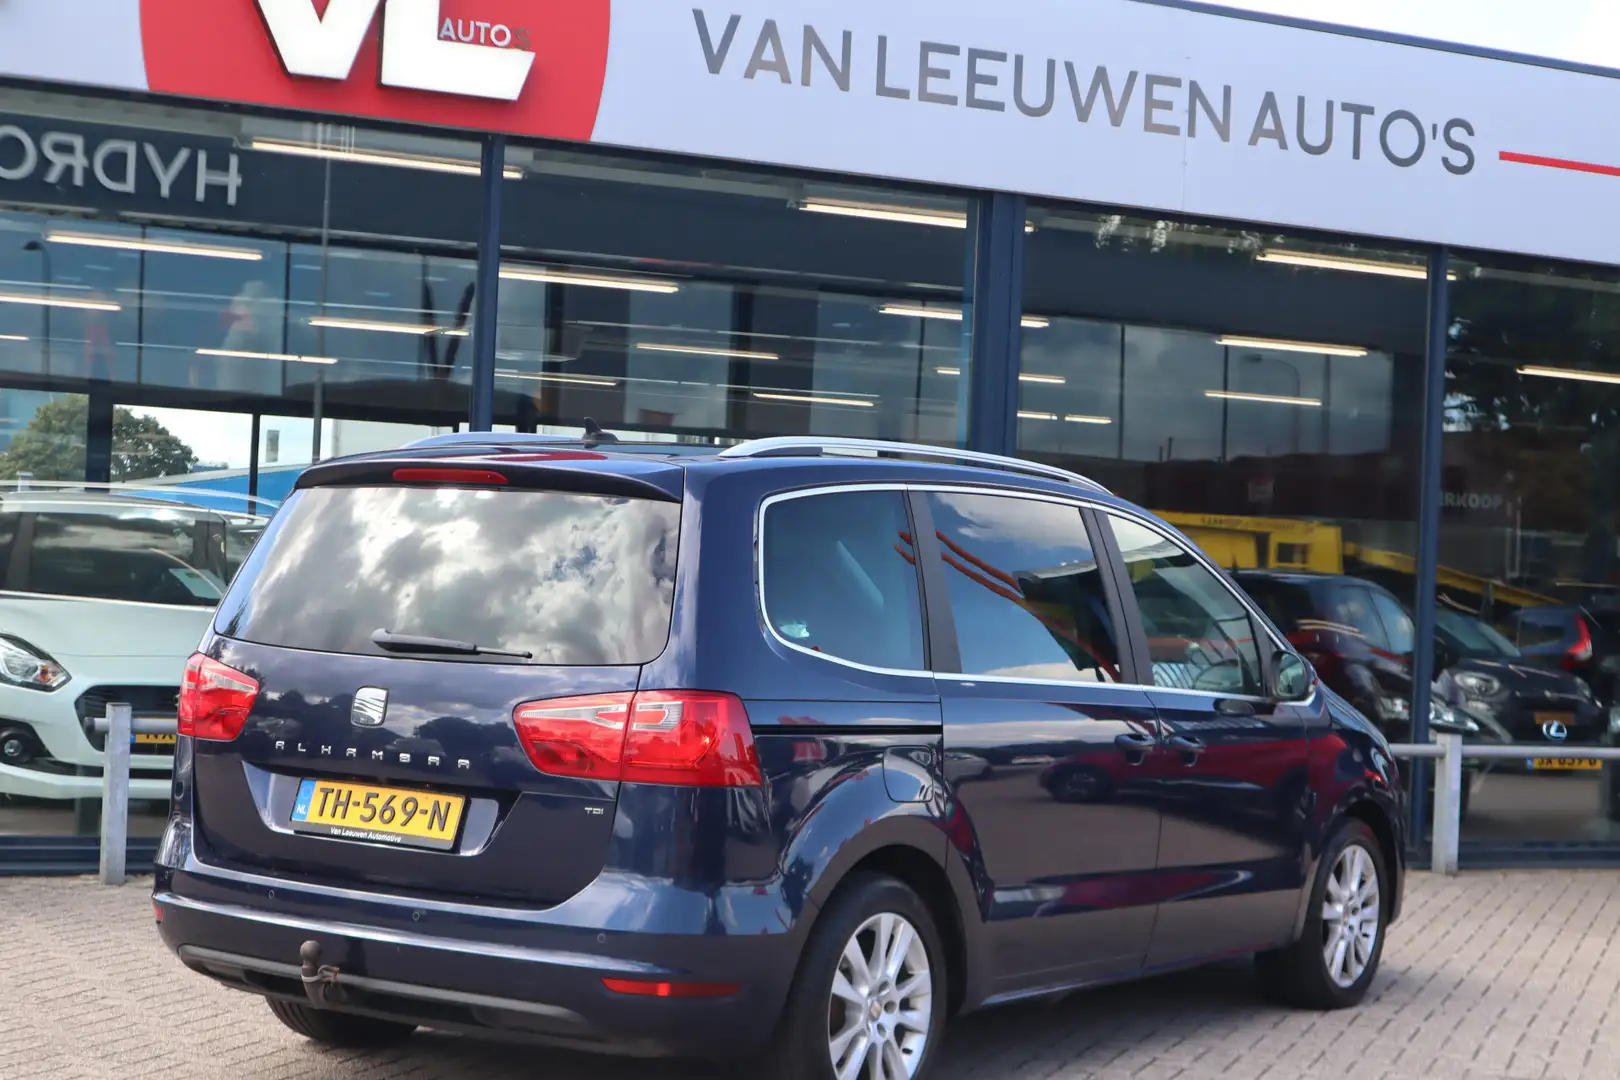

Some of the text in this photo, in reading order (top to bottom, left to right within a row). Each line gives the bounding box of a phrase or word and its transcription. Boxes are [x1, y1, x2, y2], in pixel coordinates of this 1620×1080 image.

[692, 8, 1475, 175] VAN LEEUWEN AUTO'S
[275, 740, 470, 769] ALHAMBRA
[318, 787, 451, 832] TH-569-N
[584, 806, 604, 815] TDI
[330, 826, 402, 843] Van Leeuwen Automotive
